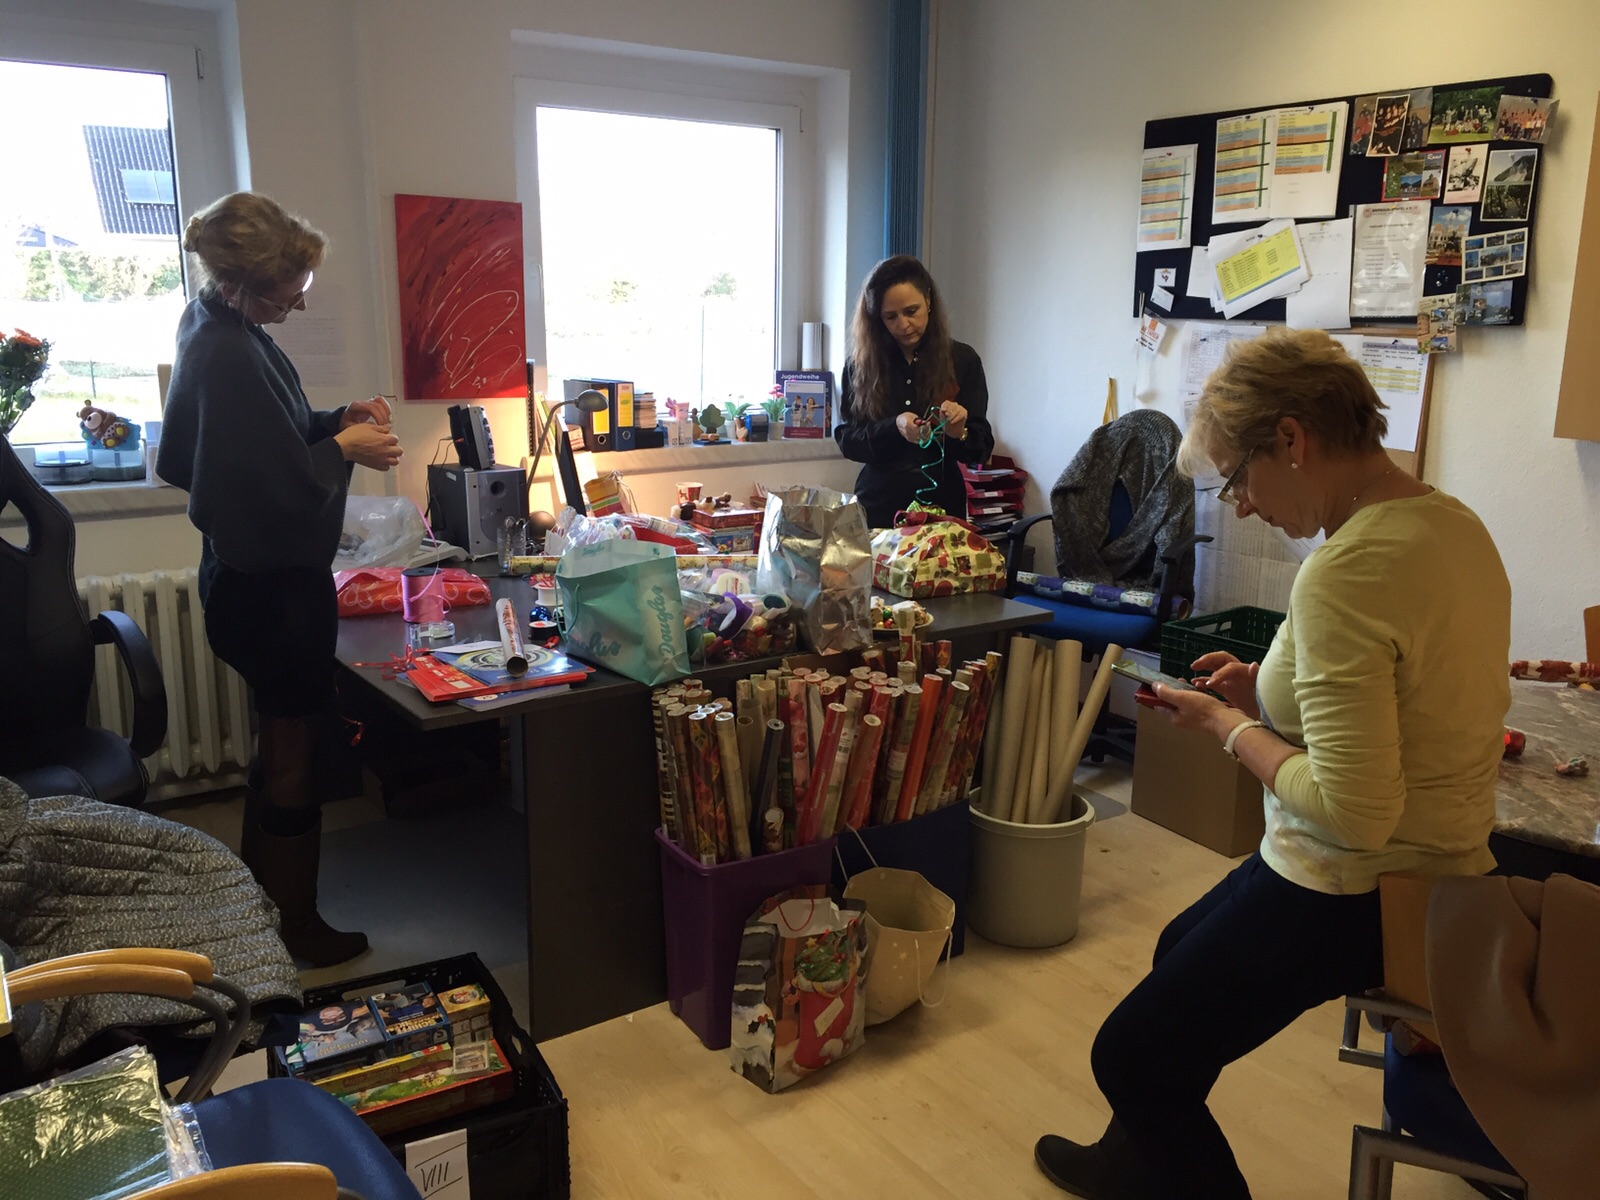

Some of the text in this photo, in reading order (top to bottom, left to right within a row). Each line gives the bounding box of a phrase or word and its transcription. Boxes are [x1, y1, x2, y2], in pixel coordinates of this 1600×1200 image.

[781, 373, 820, 381] Jugendweihe
[647, 585, 675, 656] Douglas
[421, 1161, 449, 1192] VIII
